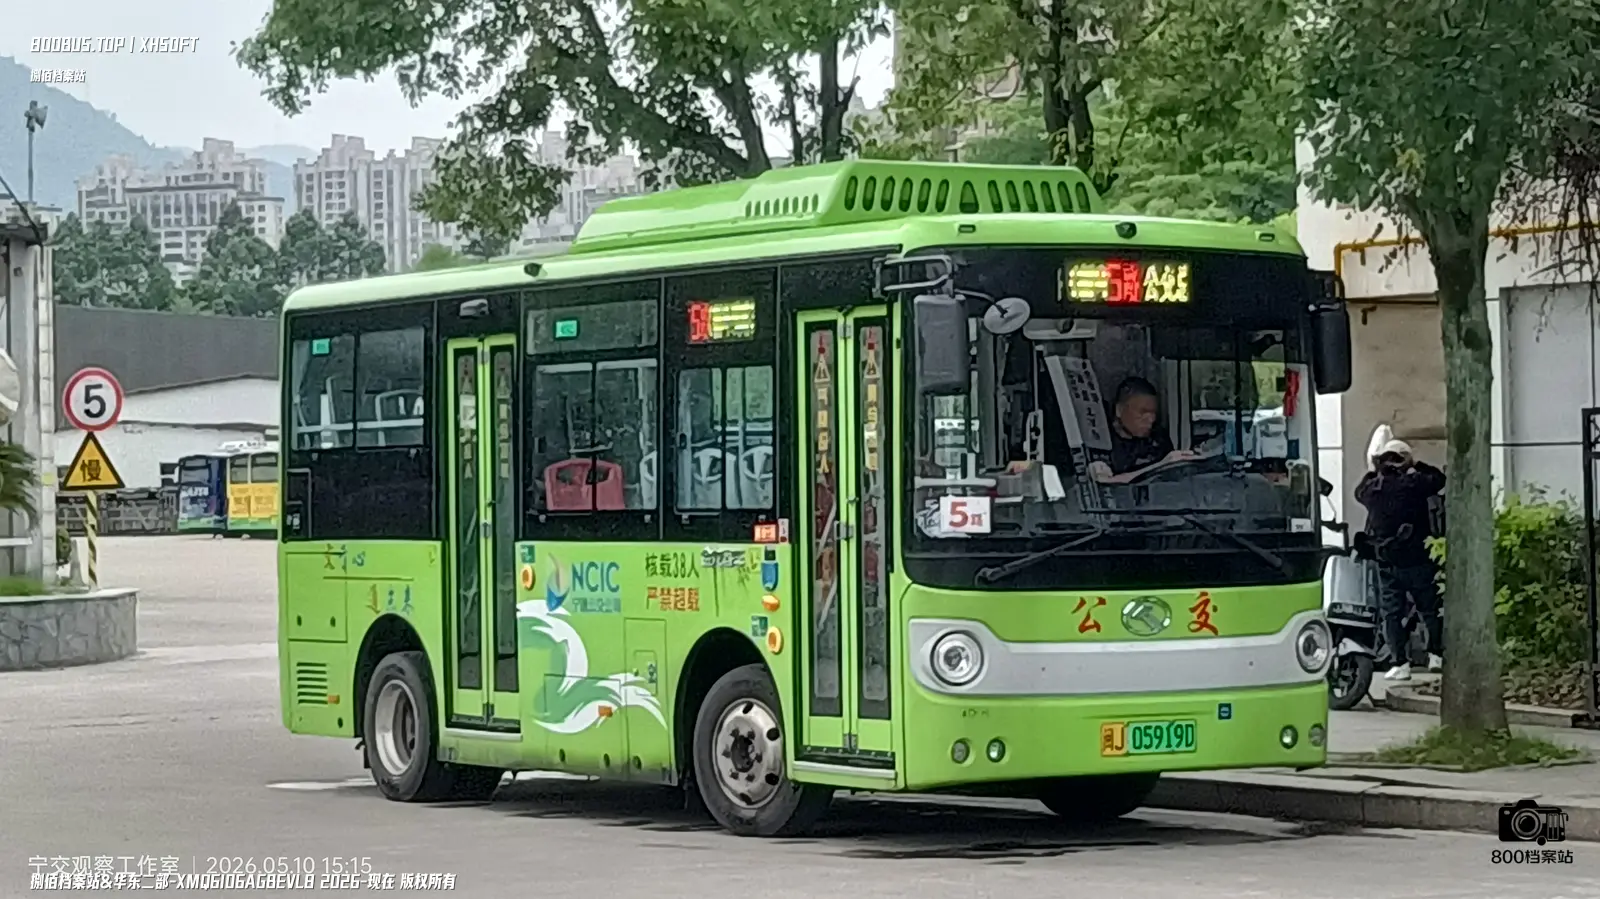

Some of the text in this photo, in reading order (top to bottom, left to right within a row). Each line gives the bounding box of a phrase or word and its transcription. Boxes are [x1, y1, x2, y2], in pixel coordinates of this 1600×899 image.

[83, 383, 106, 418] 5
[80, 459, 102, 482] 慢
[571, 561, 621, 593] NCIC
[645, 551, 700, 579] 核载38人
[645, 586, 700, 612] 严禁超载
[1070, 591, 1219, 636] 公 交
[1131, 723, 1195, 750] 05919D
